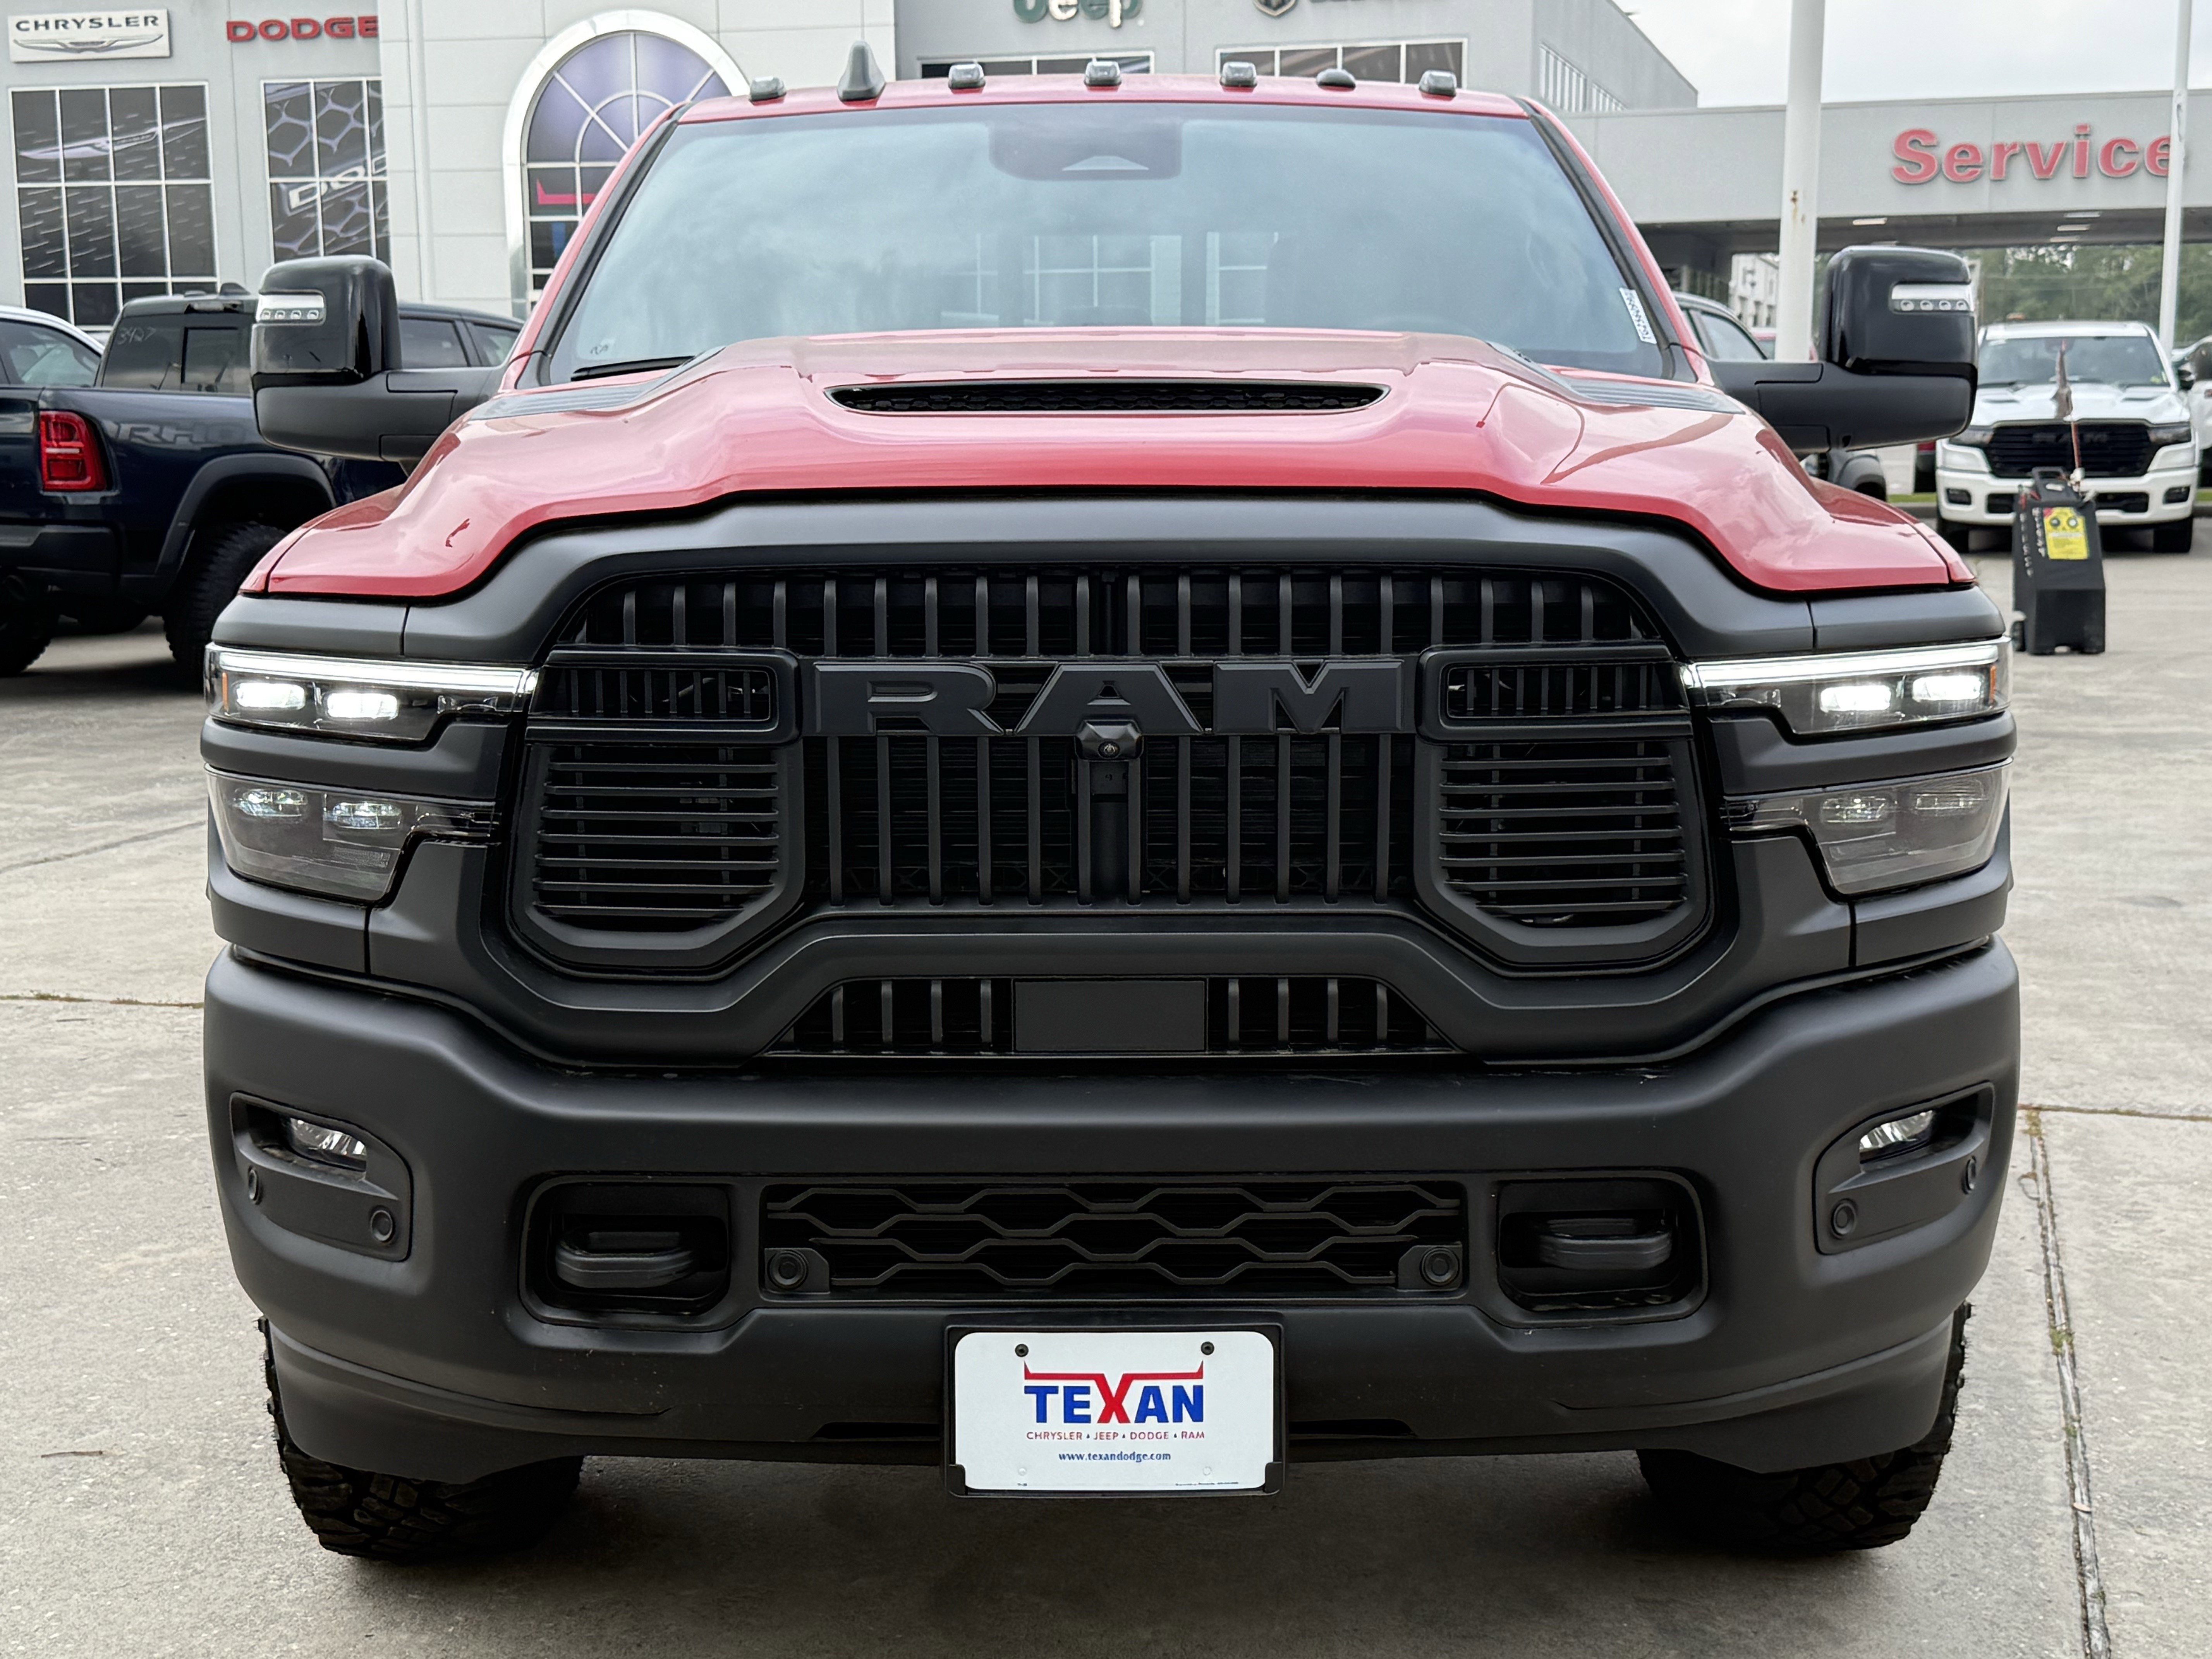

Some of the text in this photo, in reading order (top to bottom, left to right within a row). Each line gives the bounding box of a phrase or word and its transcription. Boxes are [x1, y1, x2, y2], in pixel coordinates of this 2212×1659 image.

[15, 15, 159, 32] CHRYSLER
[226, 15, 379, 41] DODGE
[1892, 123, 2171, 184] Service
[814, 661, 1405, 735] RAM
[1024, 1372, 1204, 1424] TEXAN
[1026, 1431, 1205, 1440] CHRYSLER JEEP DODGE RAM
[1058, 1451, 1171, 1462] www.texandodge.com
